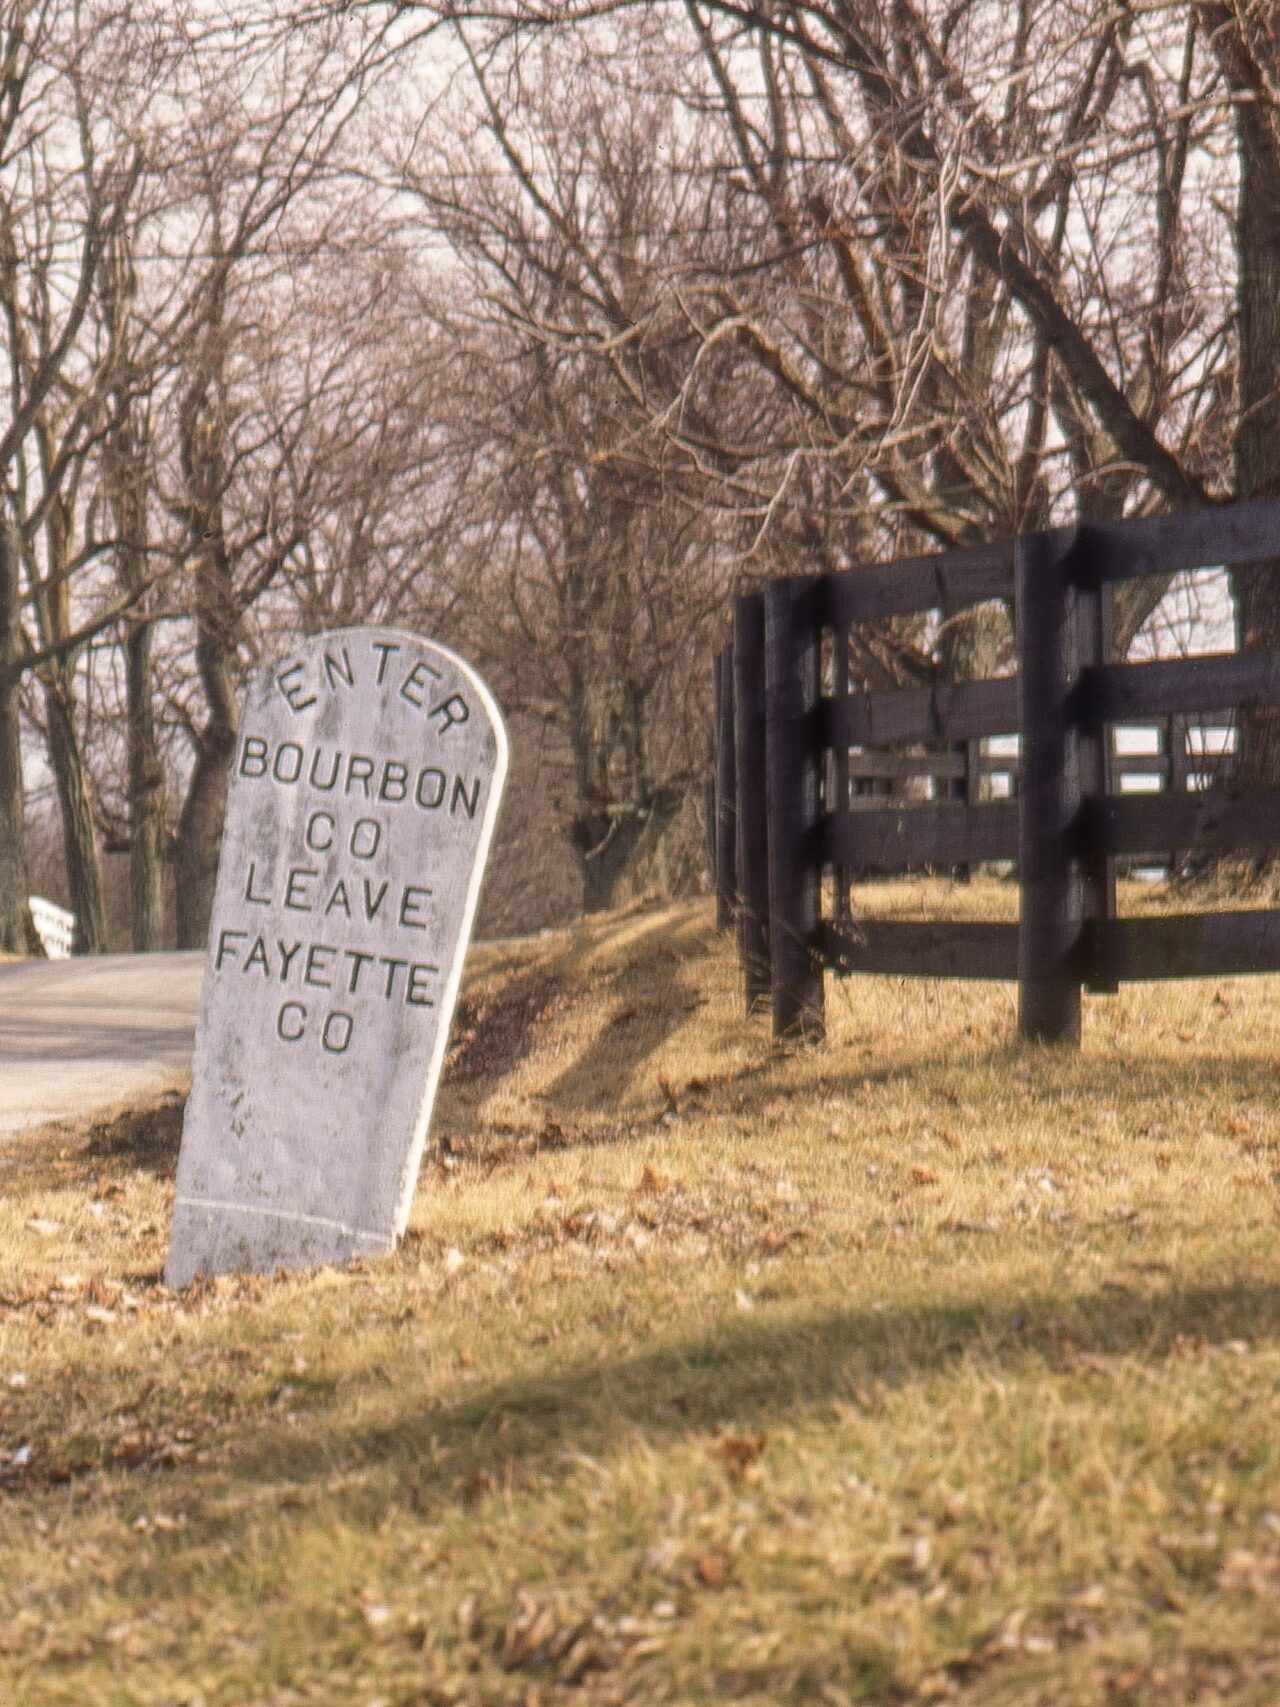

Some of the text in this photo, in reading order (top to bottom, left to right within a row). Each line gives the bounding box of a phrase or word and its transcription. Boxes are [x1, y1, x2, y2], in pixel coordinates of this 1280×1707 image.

[278, 642, 470, 736] ENTER
[240, 737, 481, 819] BOURBON
[306, 812, 381, 859] CO
[244, 863, 433, 929] LEAVE
[214, 930, 439, 1006] FAYETTE
[277, 1001, 354, 1052] CO
